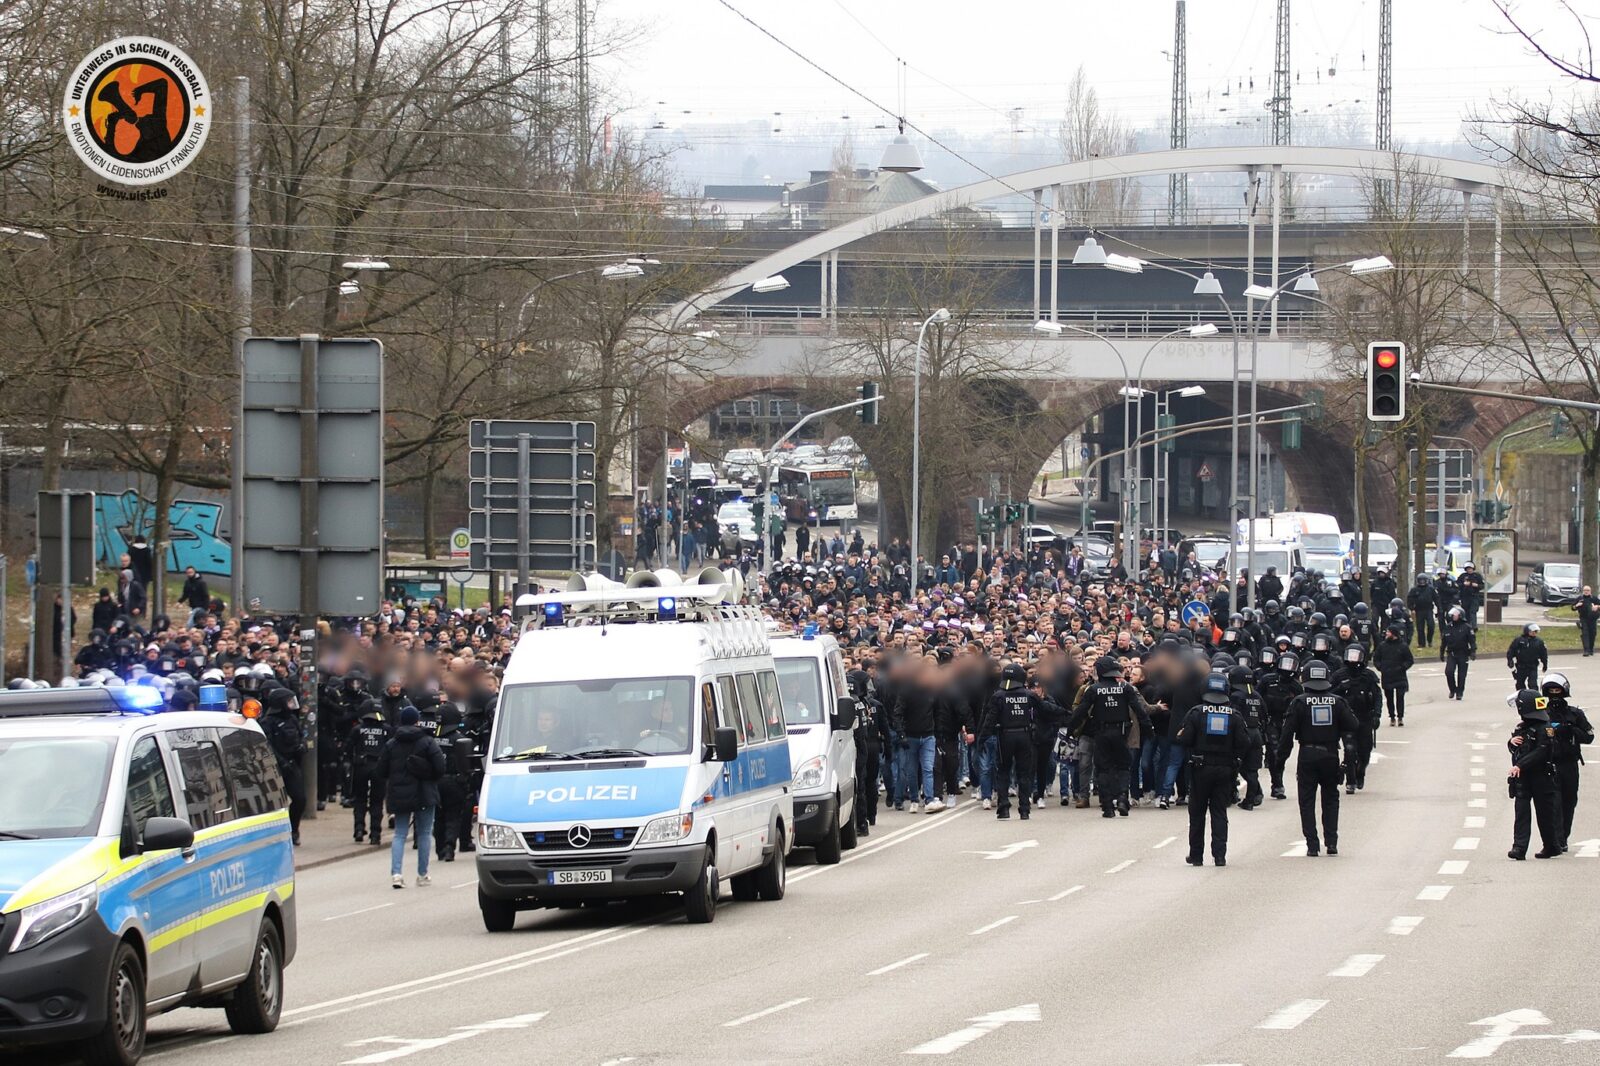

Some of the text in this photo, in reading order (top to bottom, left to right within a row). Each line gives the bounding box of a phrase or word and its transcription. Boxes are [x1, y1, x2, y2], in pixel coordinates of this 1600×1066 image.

[1097, 686, 1123, 695] POLIZEI
[1005, 696, 1028, 704] POLIZEI
[1307, 696, 1336, 705] POLIZEI
[1202, 705, 1233, 715] POLIZEI
[360, 727, 383, 735] POLIZEI
[527, 784, 638, 806] POLIZEI
[210, 861, 246, 899] POLIZEI
[559, 870, 606, 883] SB 3950
